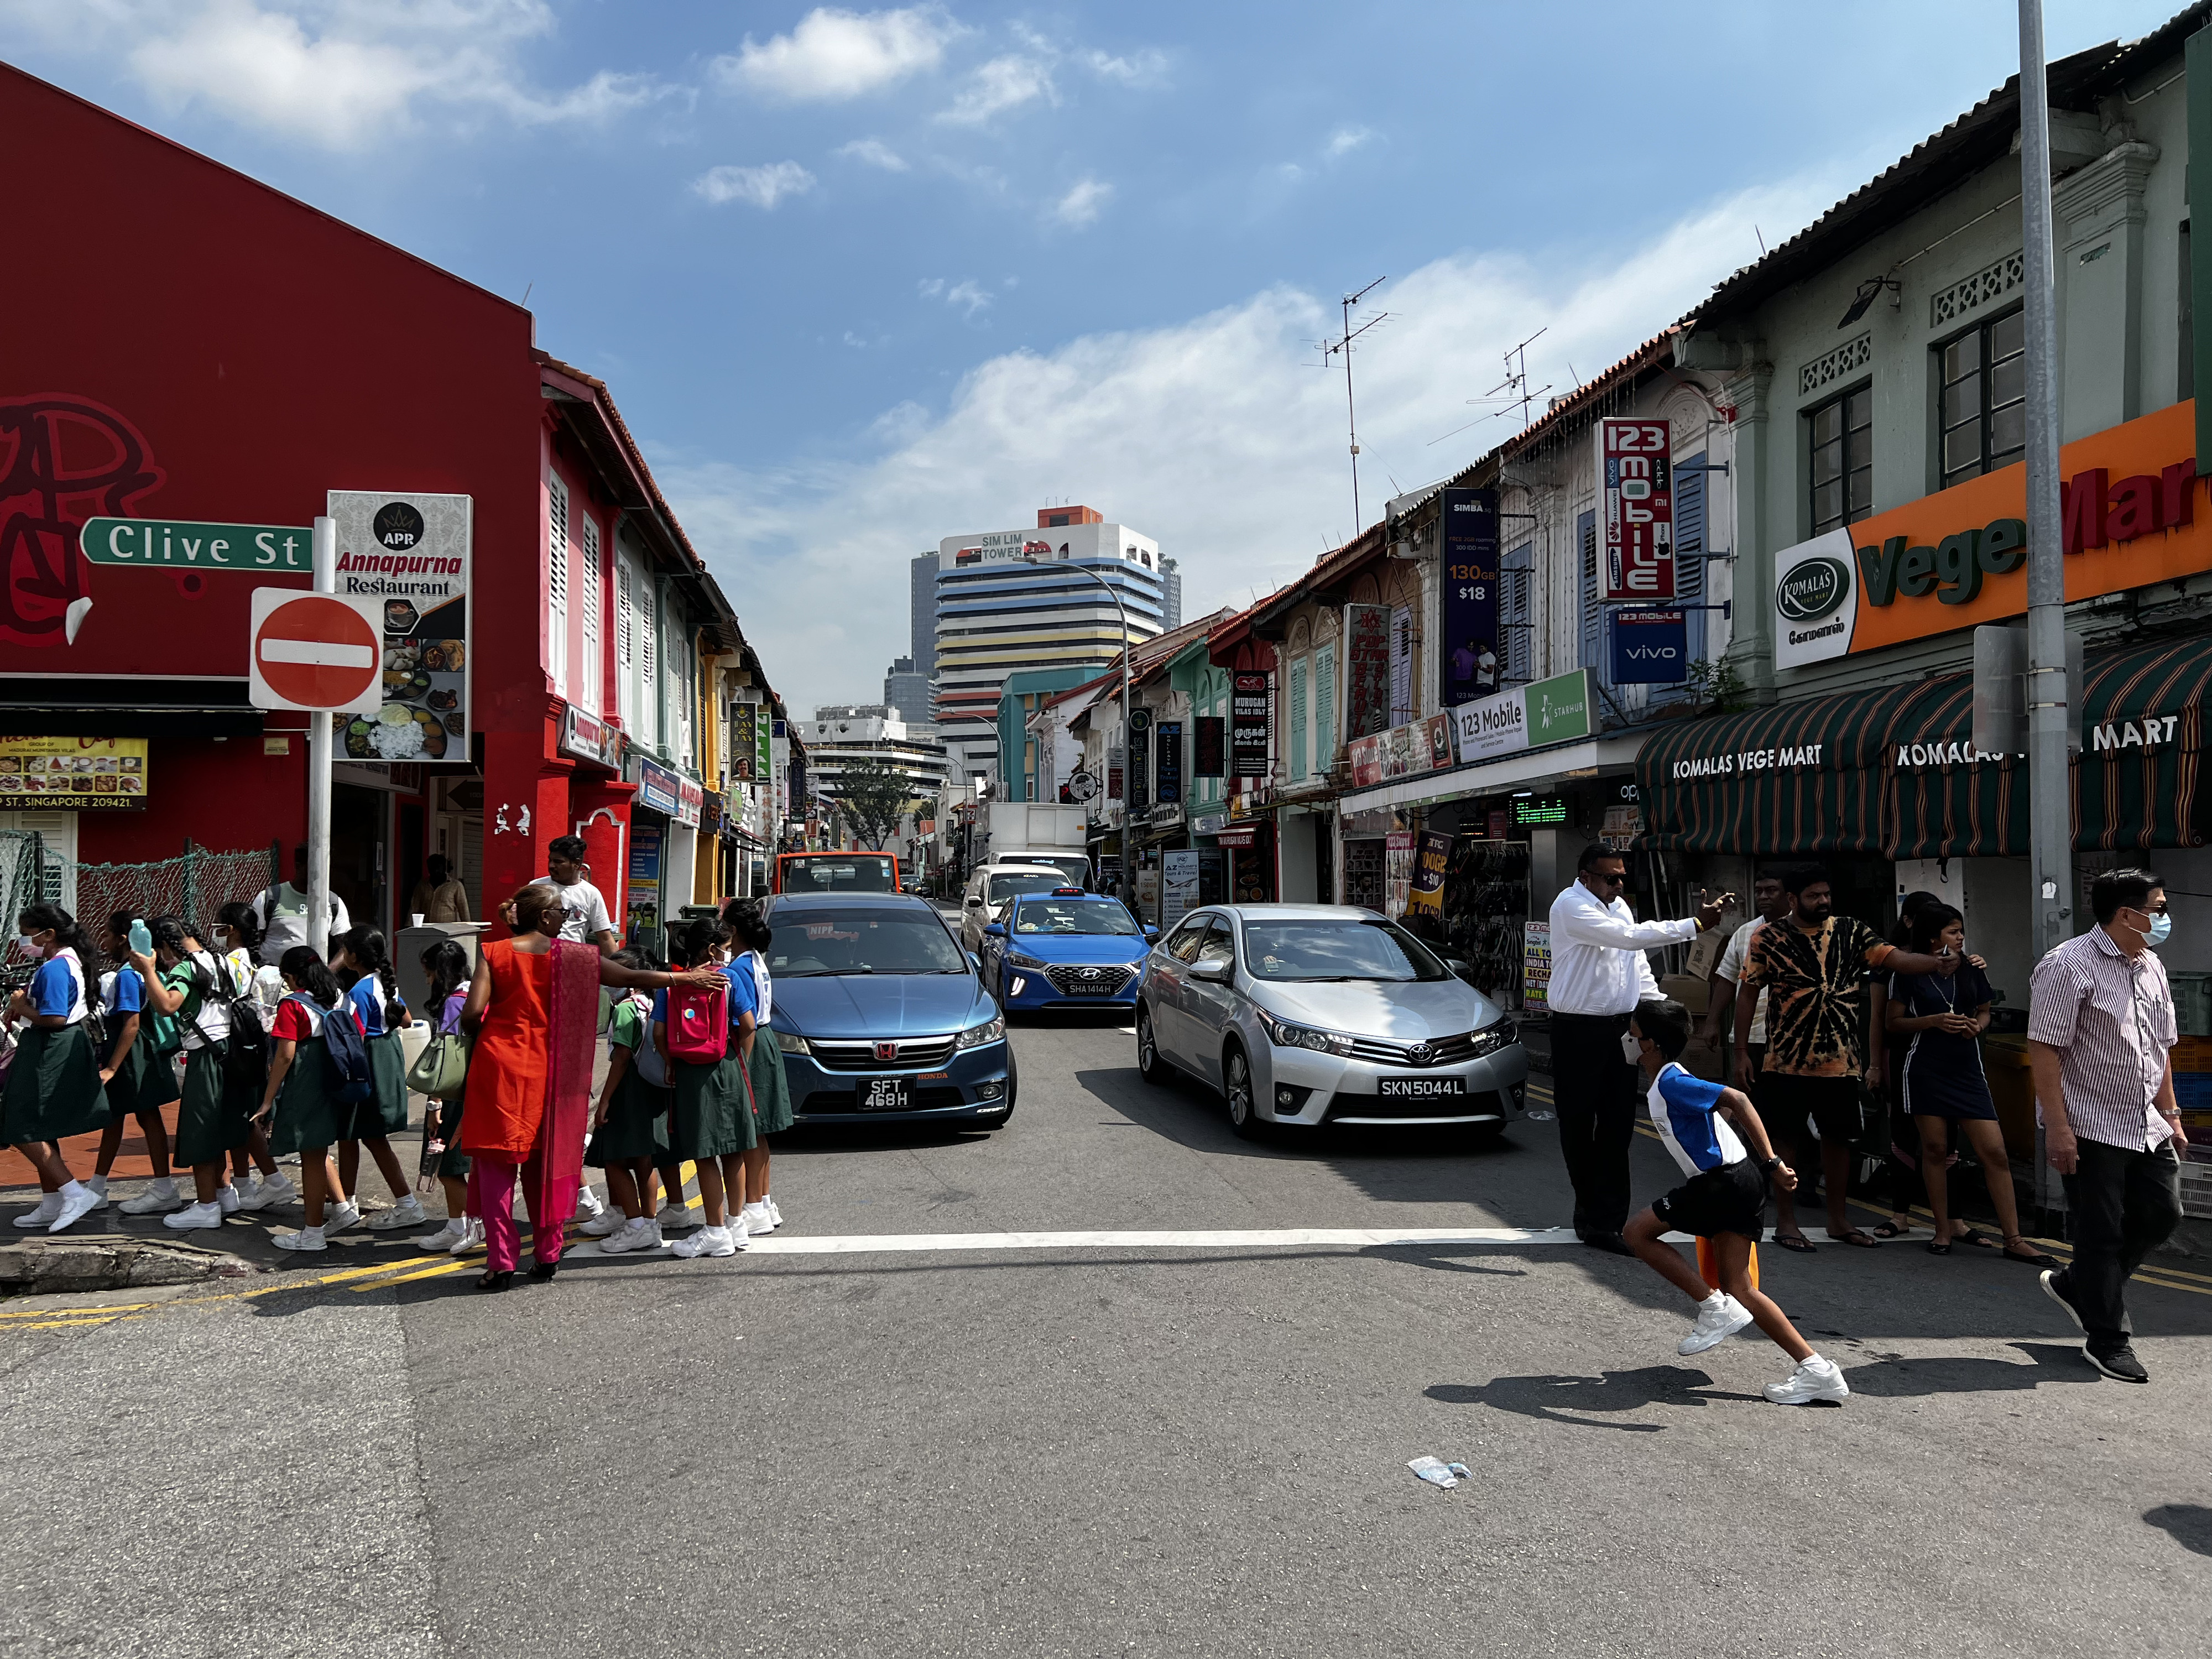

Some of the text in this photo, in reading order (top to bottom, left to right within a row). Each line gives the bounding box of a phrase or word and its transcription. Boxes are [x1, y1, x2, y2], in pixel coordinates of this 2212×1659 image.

[1608, 426, 1665, 451] 123
[2060, 458, 2212, 555] Mar
[109, 525, 299, 565] Clive St
[383, 533, 414, 545] APR
[982, 534, 1022, 547] SIM LIM
[982, 547, 1022, 559] TOWER
[336, 552, 462, 578] Annapurna
[1857, 518, 2027, 607] Vege
[1449, 565, 1496, 580] 130GB
[346, 577, 450, 596] Restaurant
[1785, 568, 1830, 604] KOMALA'S
[1459, 587, 1485, 601] $18
[1801, 592, 1829, 605] VEGE MART
[1354, 635, 1386, 648] POP
[1350, 648, 1389, 661] STAR
[1626, 644, 1676, 659] vivo
[1373, 662, 1384, 708] SALON
[1235, 697, 1266, 707] MURUGAN
[1353, 662, 1368, 737] BEAUTY
[1554, 702, 1583, 718] STARHUB
[1461, 701, 1521, 737] 123 Mobile
[1157, 725, 1181, 734] AZ
[1234, 725, 1266, 739] முருகன்
[2094, 716, 2178, 752] MART
[1673, 744, 1822, 779] KOMALAS VEGE MART
[25, 797, 87, 807] SINGAPORE
[92, 797, 133, 807] 209421.
[1428, 872, 1439, 886] $10
[1526, 948, 1551, 958] ALL TO
[1526, 958, 1545, 968] INDIA
[1528, 969, 1551, 978] RECHA
[1070, 985, 1111, 993] SHA1414H
[1526, 979, 1536, 988] NET
[1526, 990, 1543, 998] RATE
[872, 1079, 901, 1094] SFT
[1382, 1081, 1464, 1095] SKN5044L
[865, 1092, 907, 1107] 468H
